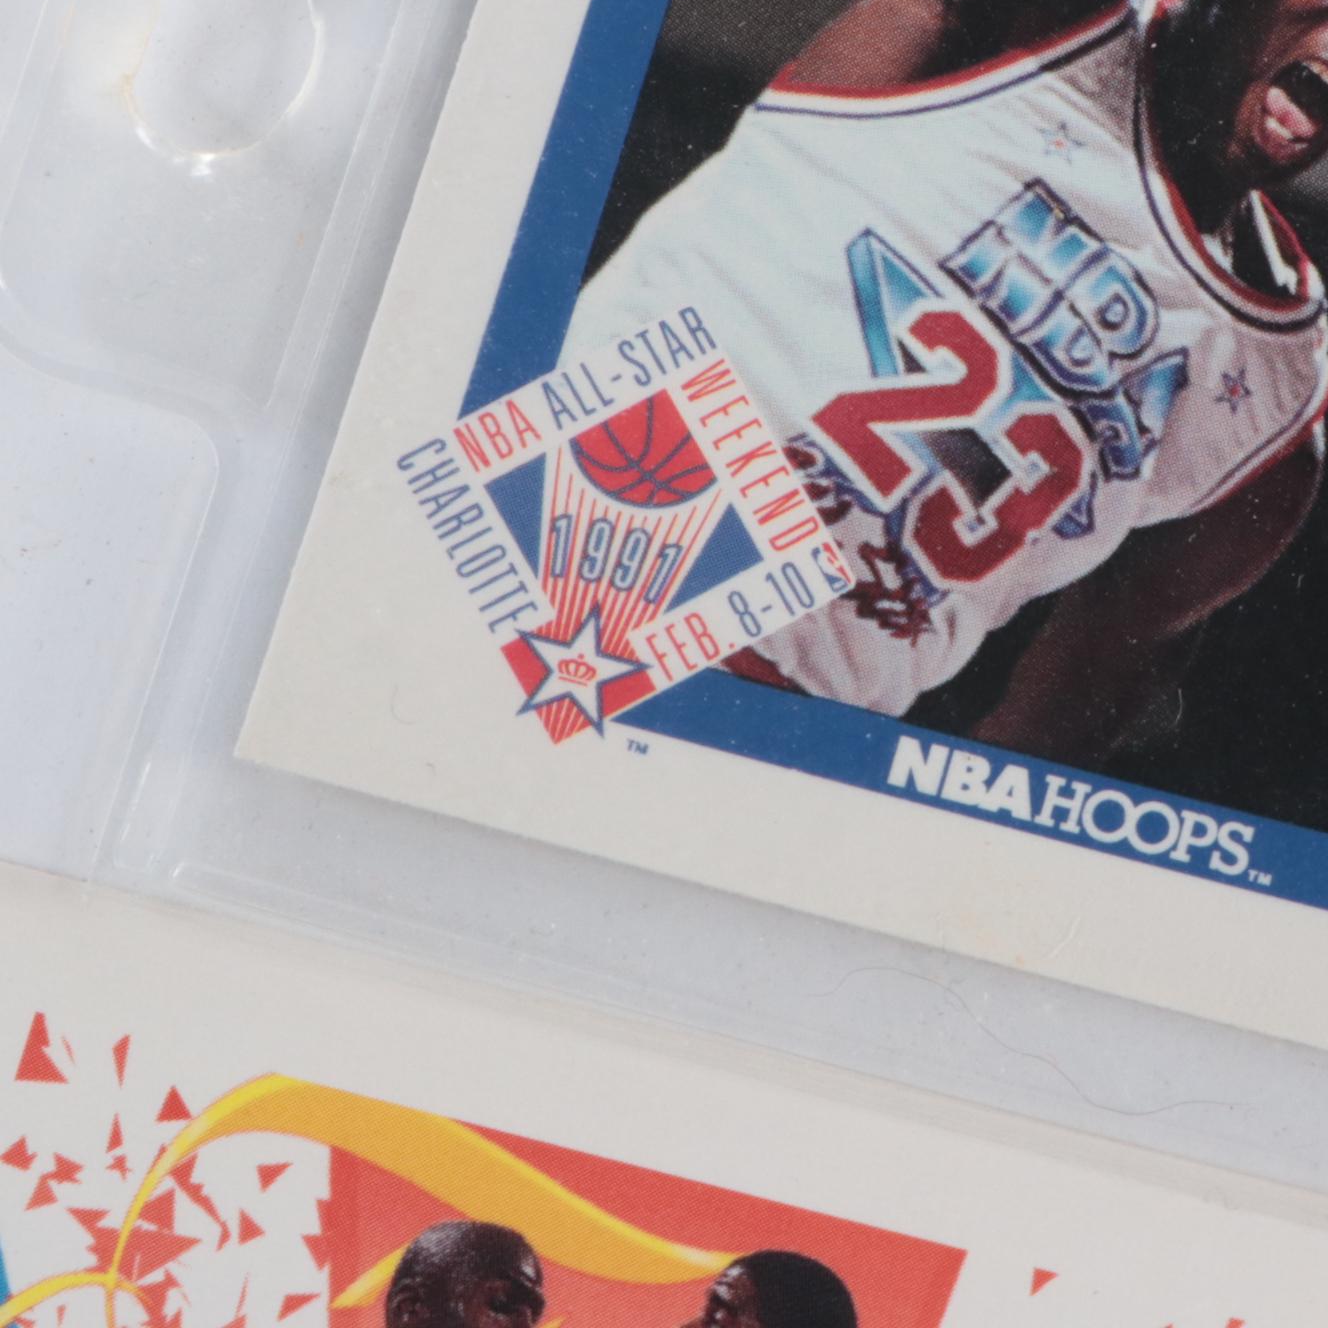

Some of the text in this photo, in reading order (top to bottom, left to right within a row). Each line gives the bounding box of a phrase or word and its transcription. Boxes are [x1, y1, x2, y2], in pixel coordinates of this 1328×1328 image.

[452, 303, 718, 474] NBA ALL-STAR
[679, 358, 822, 554] WEEKEND
[808, 304, 1086, 586] 23
[395, 436, 540, 636] CHARLOTTE
[549, 513, 685, 606] 1991
[645, 560, 818, 683] FEB. 8-10
